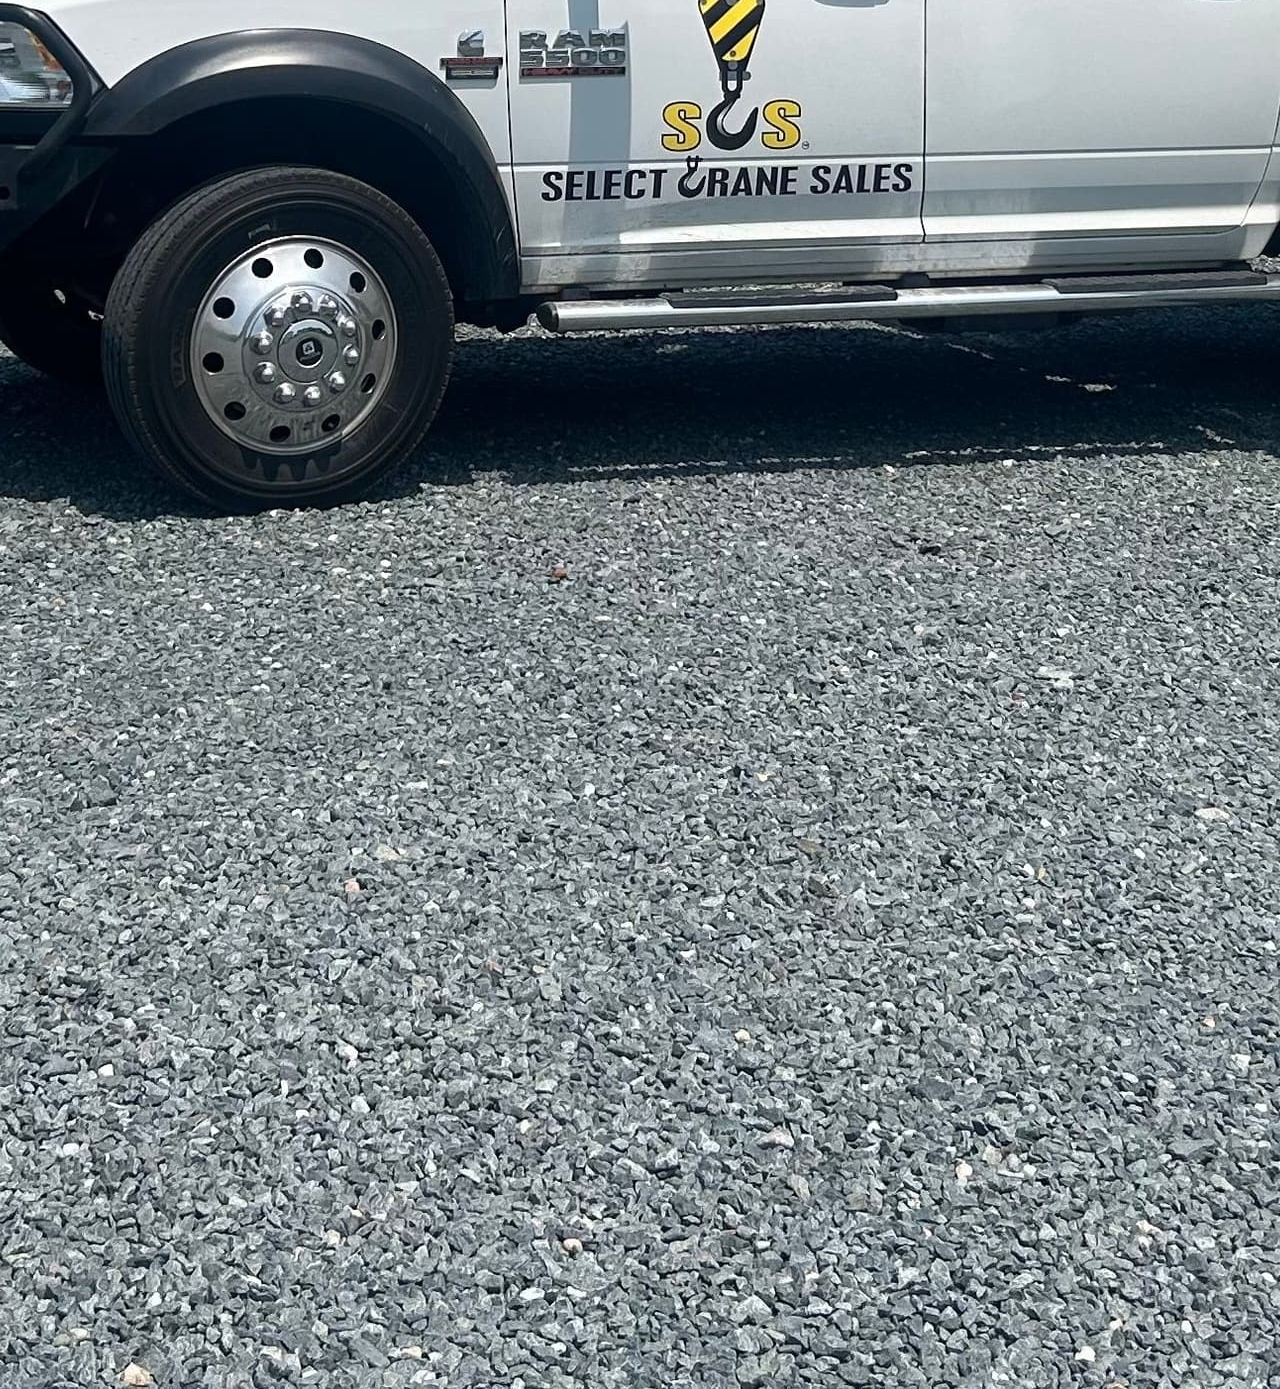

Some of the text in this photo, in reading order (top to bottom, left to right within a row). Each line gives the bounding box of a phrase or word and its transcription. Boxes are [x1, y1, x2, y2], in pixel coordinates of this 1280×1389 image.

[519, 29, 626, 49] RAM
[519, 48, 626, 66] 5500
[541, 169, 668, 202] SELECT
[810, 163, 913, 194] SALES
